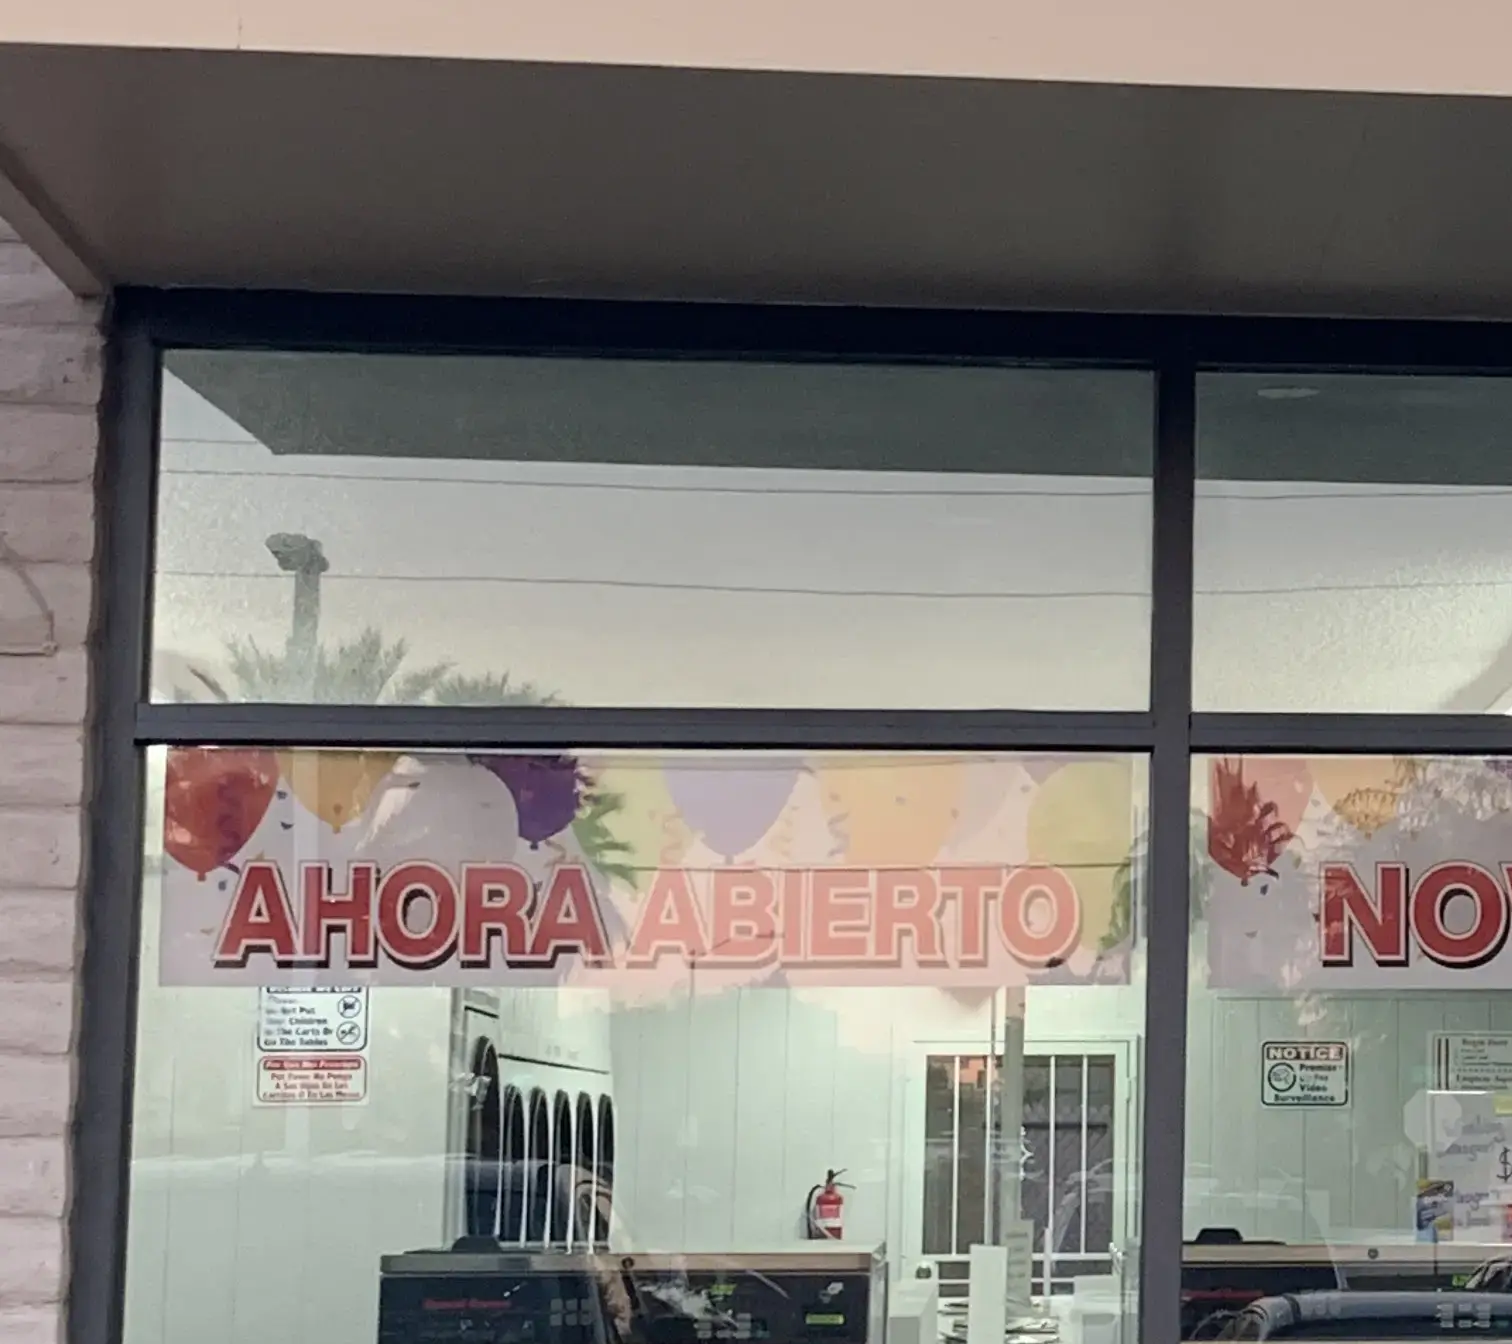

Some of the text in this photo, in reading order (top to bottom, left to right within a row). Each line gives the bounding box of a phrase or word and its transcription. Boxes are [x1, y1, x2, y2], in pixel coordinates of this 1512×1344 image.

[213, 859, 1082, 970] AHORA ABIERTO
[1268, 1047, 1341, 1060] NOTICE
